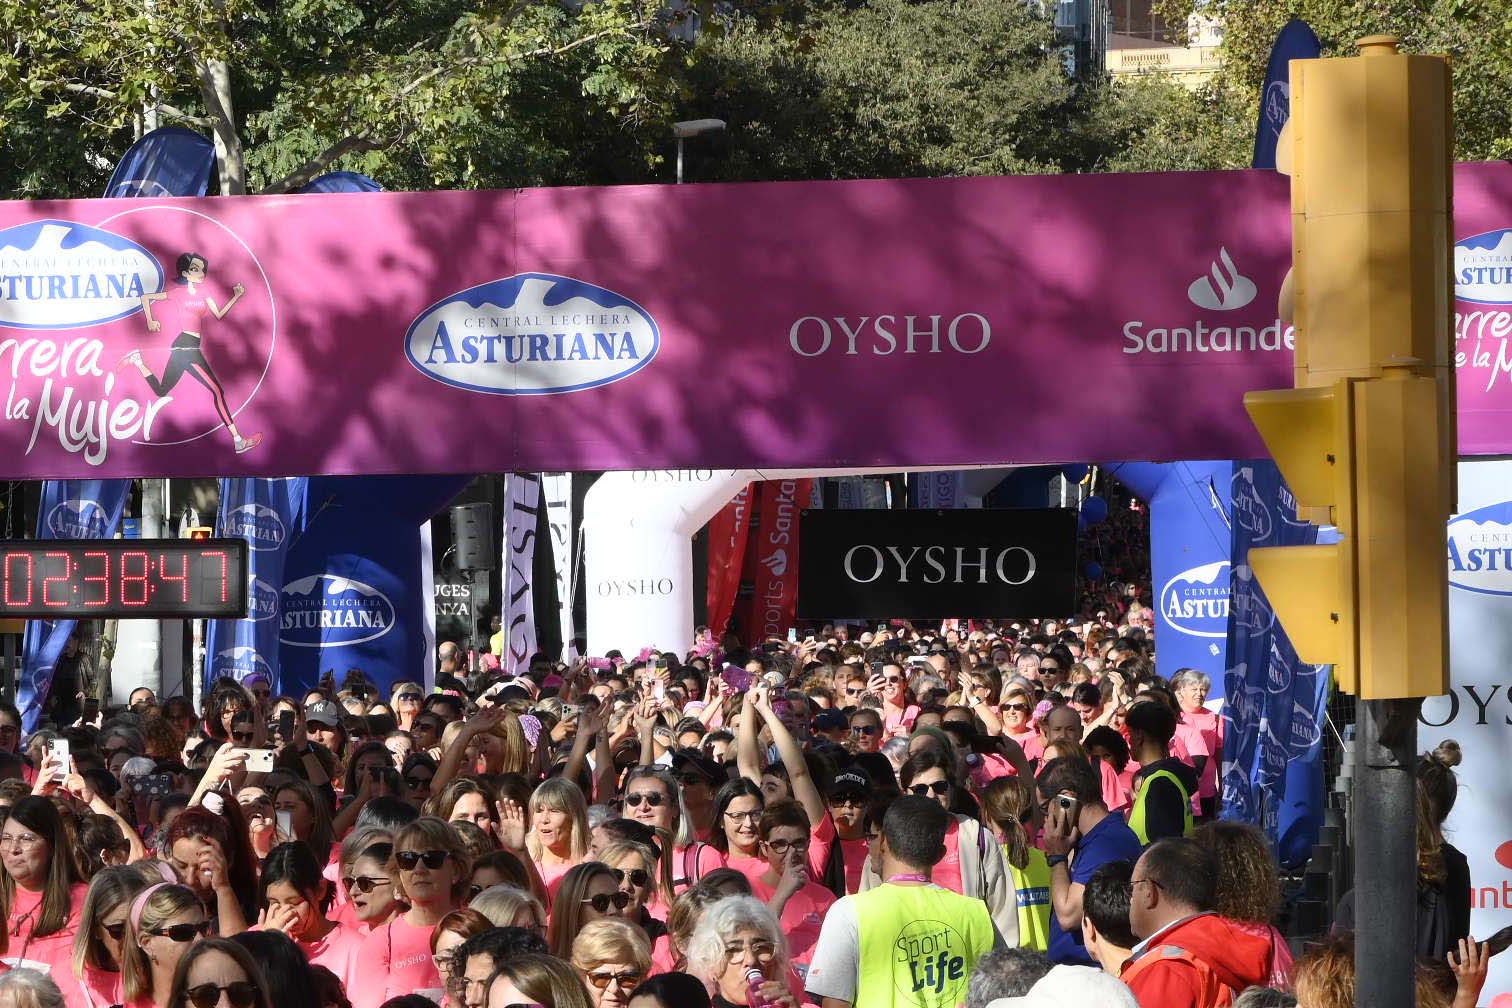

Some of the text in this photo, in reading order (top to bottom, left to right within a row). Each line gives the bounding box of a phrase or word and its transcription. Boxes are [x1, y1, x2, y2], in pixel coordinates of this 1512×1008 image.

[463, 312, 632, 328] CENTRAL LECHERA
[789, 313, 991, 357] OYSHO
[1122, 318, 1295, 355] Santande
[424, 320, 640, 364] ASTURIANA
[1454, 351, 1467, 368] e
[1472, 342, 1490, 369] la
[4, 381, 31, 420] la
[24, 371, 173, 465] Mujer
[769, 477, 796, 546] Santa
[1469, 533, 1512, 542] CENT
[4, 552, 227, 605] 02:38:47
[843, 543, 1038, 585] OYSHO
[434, 585, 470, 599] UGES
[597, 577, 675, 598] OYSHO
[1167, 589, 1231, 619] ASTU
[435, 603, 470, 617] NYA
[762, 580, 791, 645] ports
[394, 953, 428, 970] OYSHO
[897, 926, 952, 963] Sport
[909, 950, 965, 994] Life
